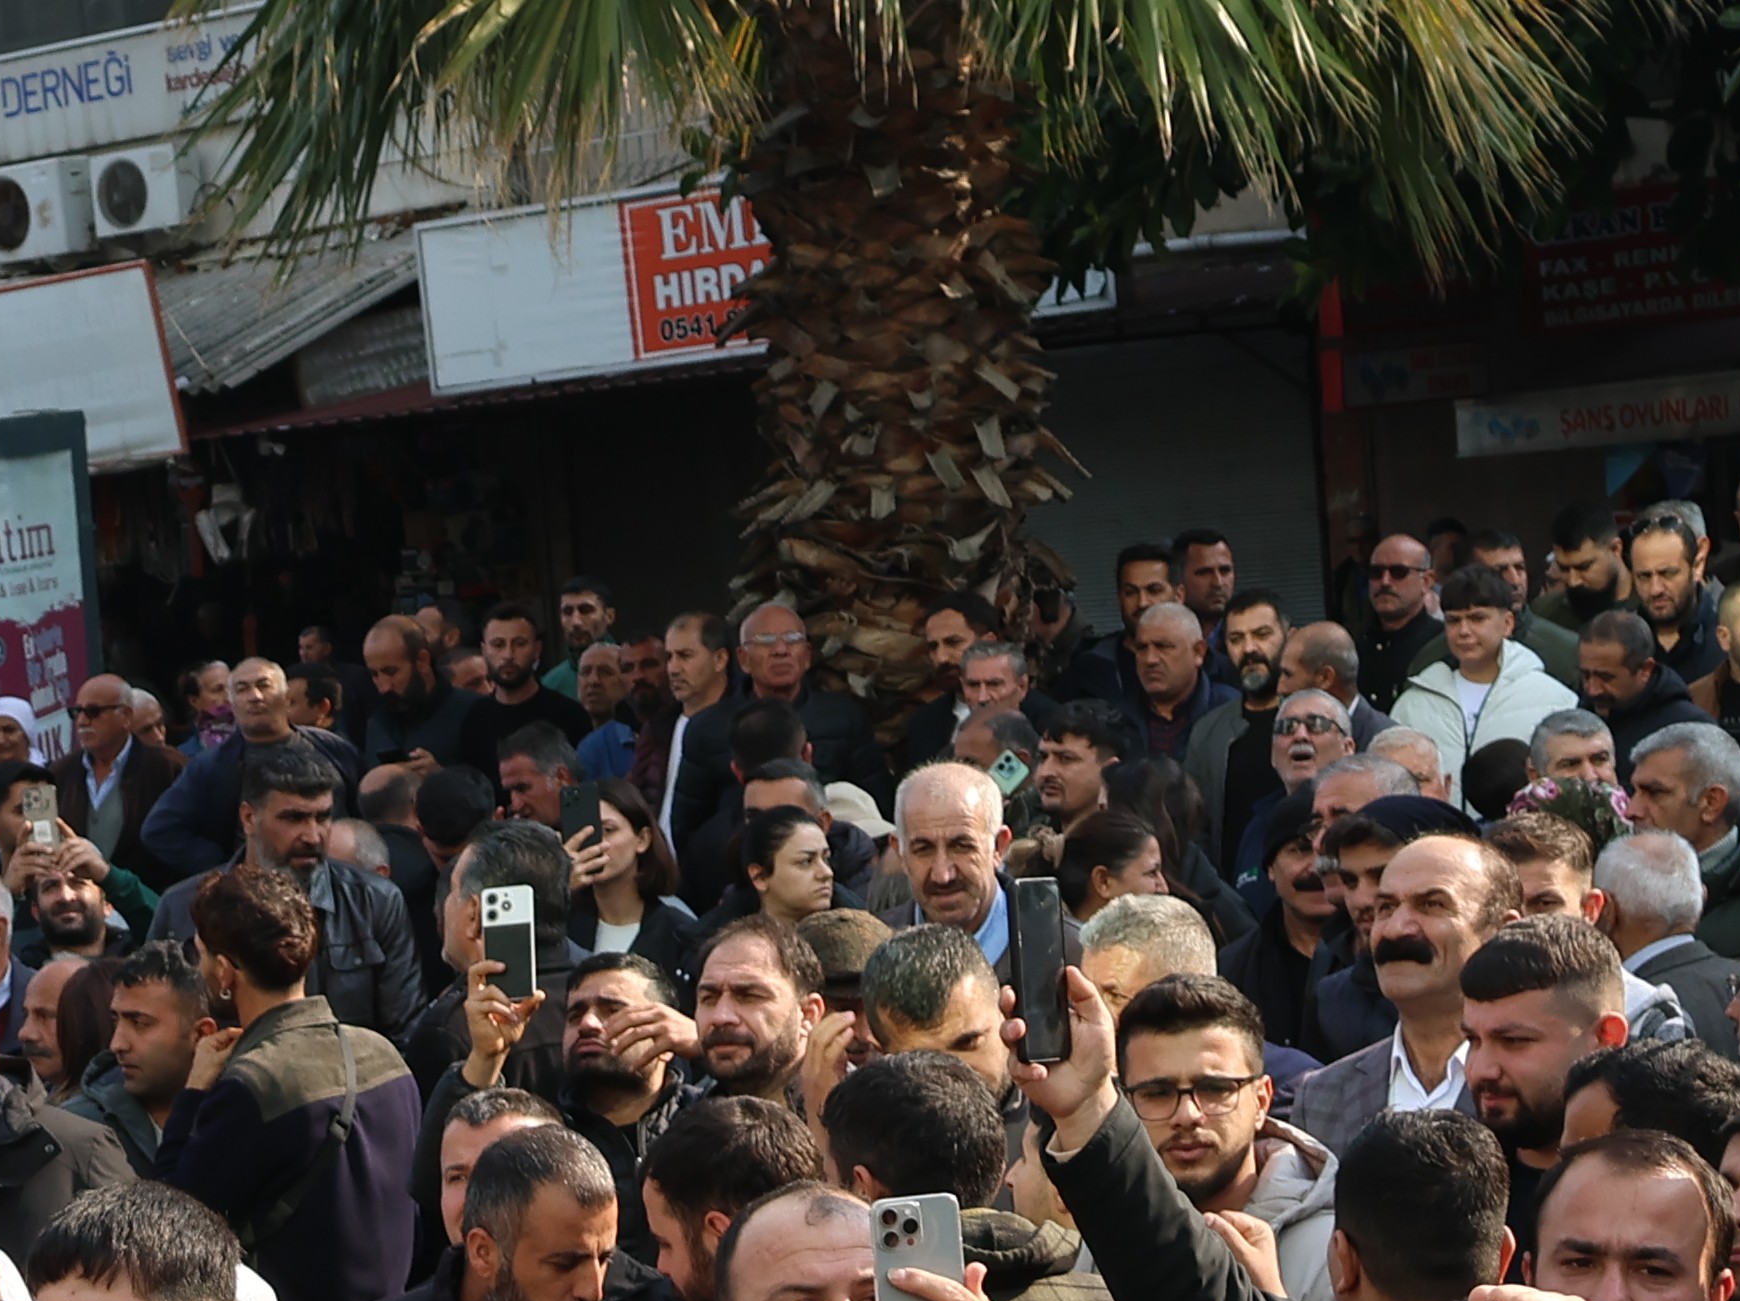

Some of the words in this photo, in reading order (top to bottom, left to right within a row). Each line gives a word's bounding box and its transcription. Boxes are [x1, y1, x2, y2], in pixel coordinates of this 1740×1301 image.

[1, 51, 133, 118] DERNEĞİ
[1538, 255, 1589, 278] FAX
[1541, 276, 1618, 303] KAŞE
[1619, 394, 1729, 429] OYUNLARI
